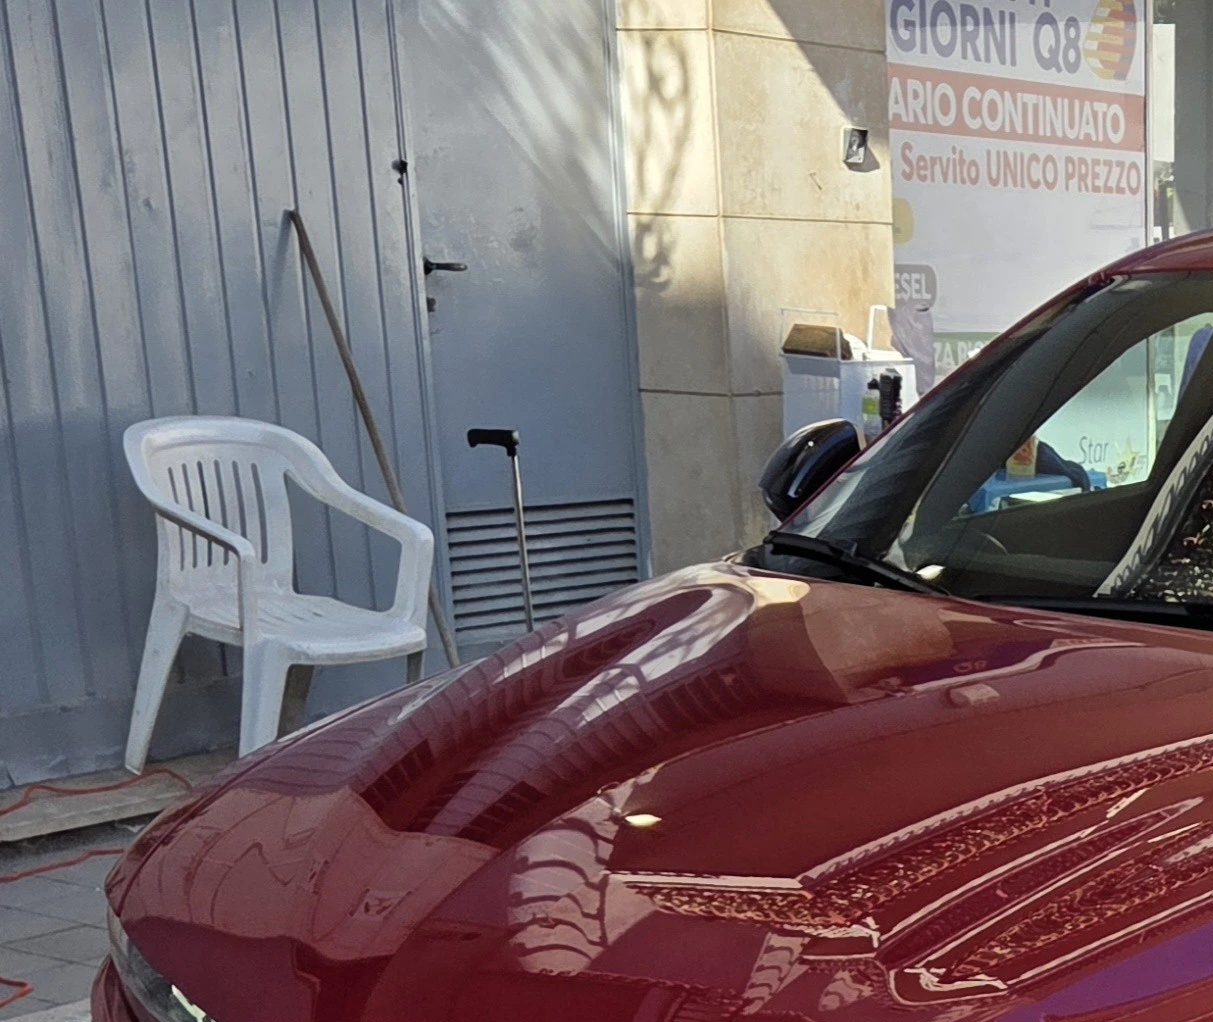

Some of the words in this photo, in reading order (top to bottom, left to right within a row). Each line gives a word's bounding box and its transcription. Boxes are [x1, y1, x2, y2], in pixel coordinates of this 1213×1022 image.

[889, 0, 1018, 67] GIORNI
[1032, 11, 1082, 75] Q8
[888, 76, 957, 127] ARIO
[962, 86, 1126, 145] CONTINUATO
[901, 141, 980, 187] Servito
[986, 149, 1059, 191] UNICO
[1064, 156, 1142, 196] PREZZO
[1078, 435, 1110, 465] Star
